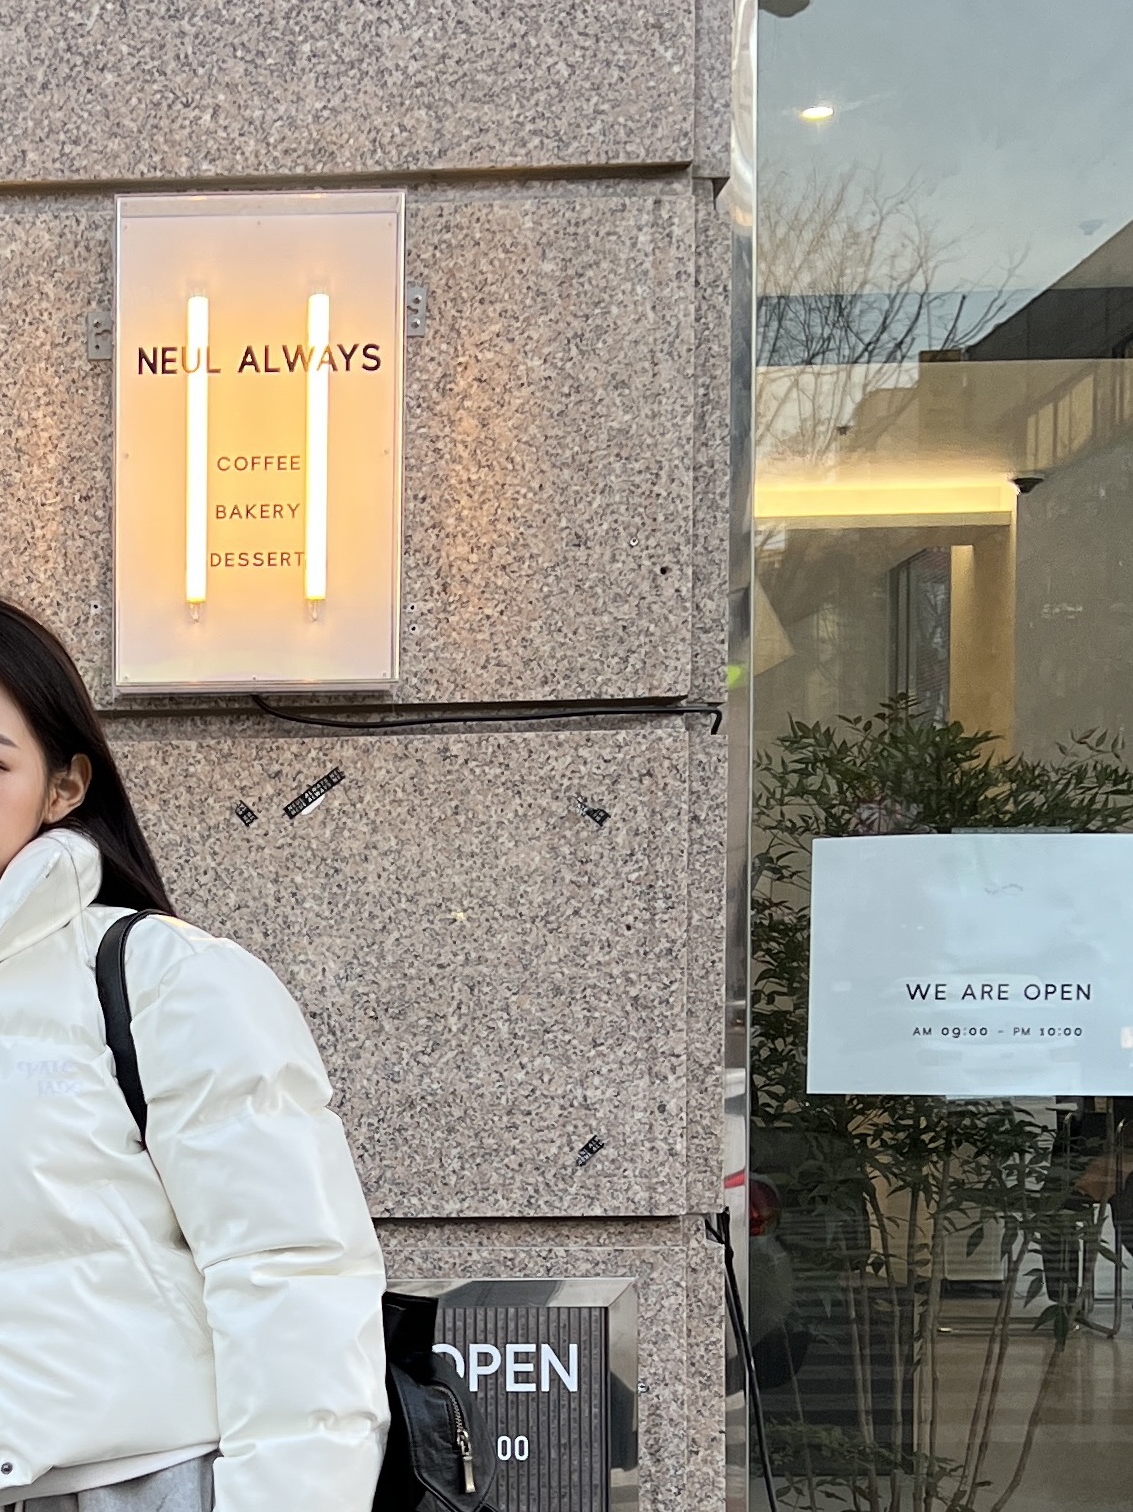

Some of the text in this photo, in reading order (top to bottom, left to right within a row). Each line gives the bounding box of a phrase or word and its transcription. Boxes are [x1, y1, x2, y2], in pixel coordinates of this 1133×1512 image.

[138, 343, 382, 375] NEUL ALWAYS
[216, 455, 301, 472] COFFEE
[215, 503, 301, 520] BAKERY
[210, 552, 305, 567] DESSERT
[906, 983, 1092, 1001] WE ARE OPEN
[912, 1027, 932, 1036] AM
[941, 1027, 988, 1038] 09:00
[1013, 1027, 1031, 1036] PM
[1039, 1027, 1083, 1037] 10:00
